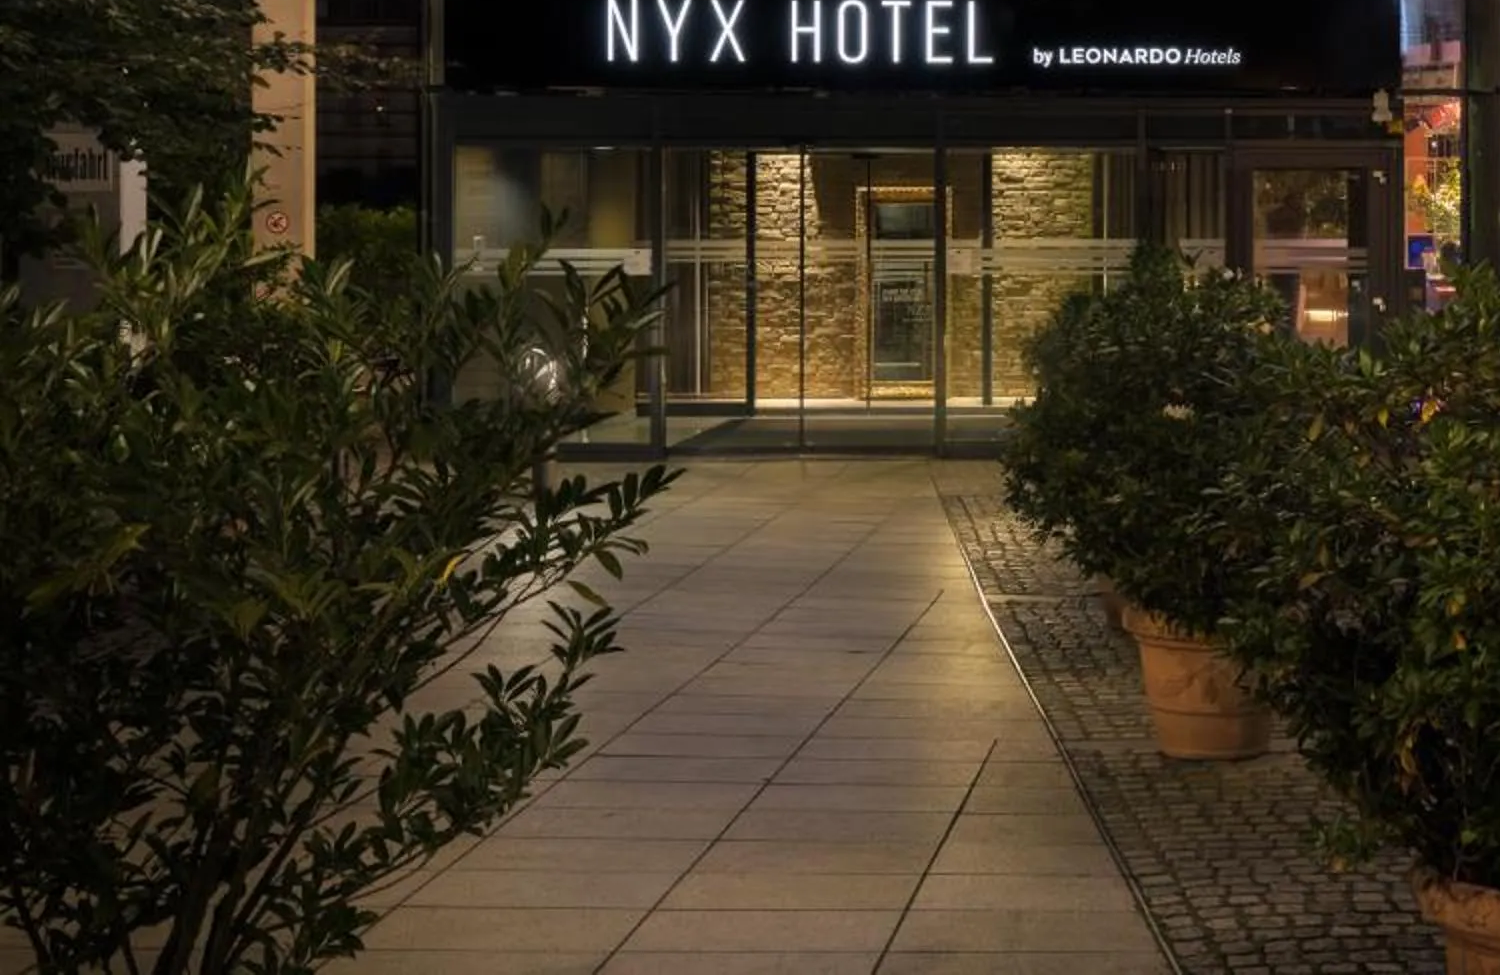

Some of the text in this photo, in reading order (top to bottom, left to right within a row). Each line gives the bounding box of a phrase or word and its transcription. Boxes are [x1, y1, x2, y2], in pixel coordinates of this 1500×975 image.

[1032, 47, 1241, 68] by LEONARDO Hotels
